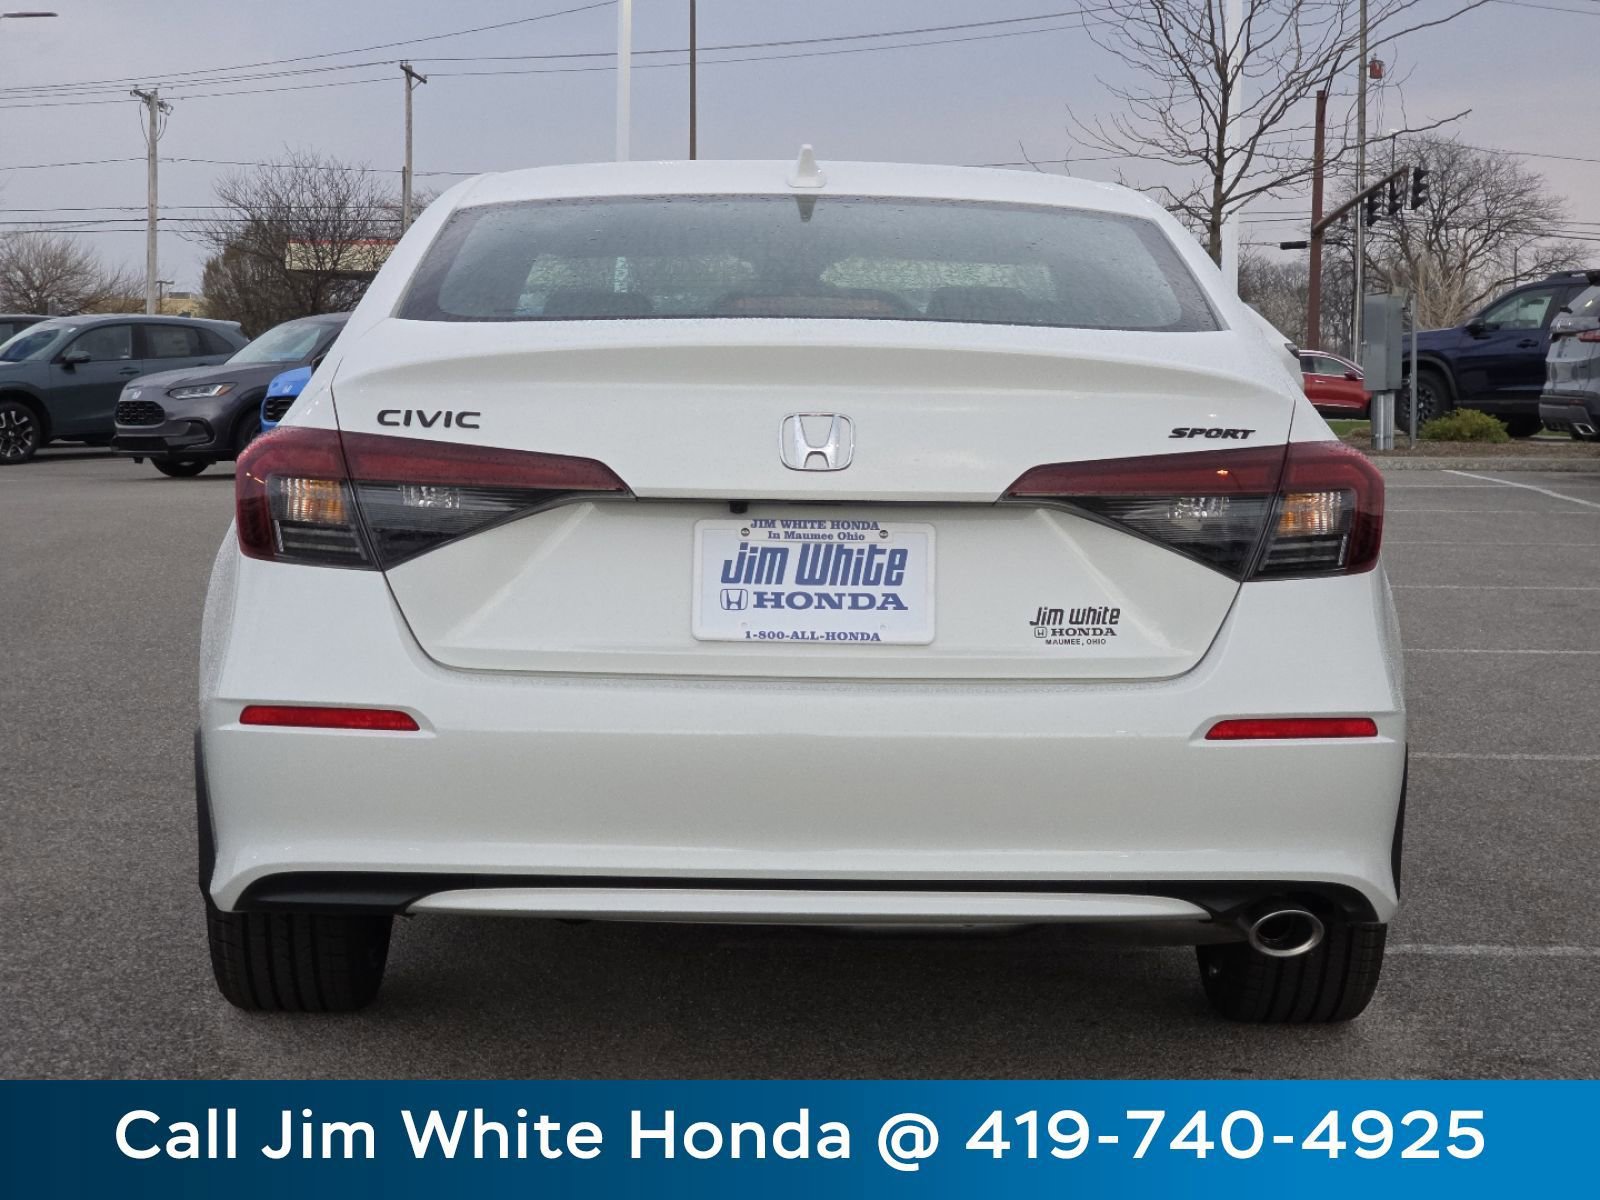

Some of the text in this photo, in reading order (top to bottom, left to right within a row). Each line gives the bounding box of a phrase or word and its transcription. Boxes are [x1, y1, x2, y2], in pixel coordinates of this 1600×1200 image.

[377, 409, 481, 430] CIVIC
[1168, 427, 1256, 440] SPORT
[750, 519, 881, 531] JIM WHITE HONDA
[767, 530, 865, 541] In Maumee Ohio
[795, 543, 908, 587] White
[753, 591, 908, 611] HONDA
[1029, 606, 1064, 626] Jim
[745, 630, 881, 642] 1-800-ALL-HONDA
[1050, 627, 1117, 637] HONDA
